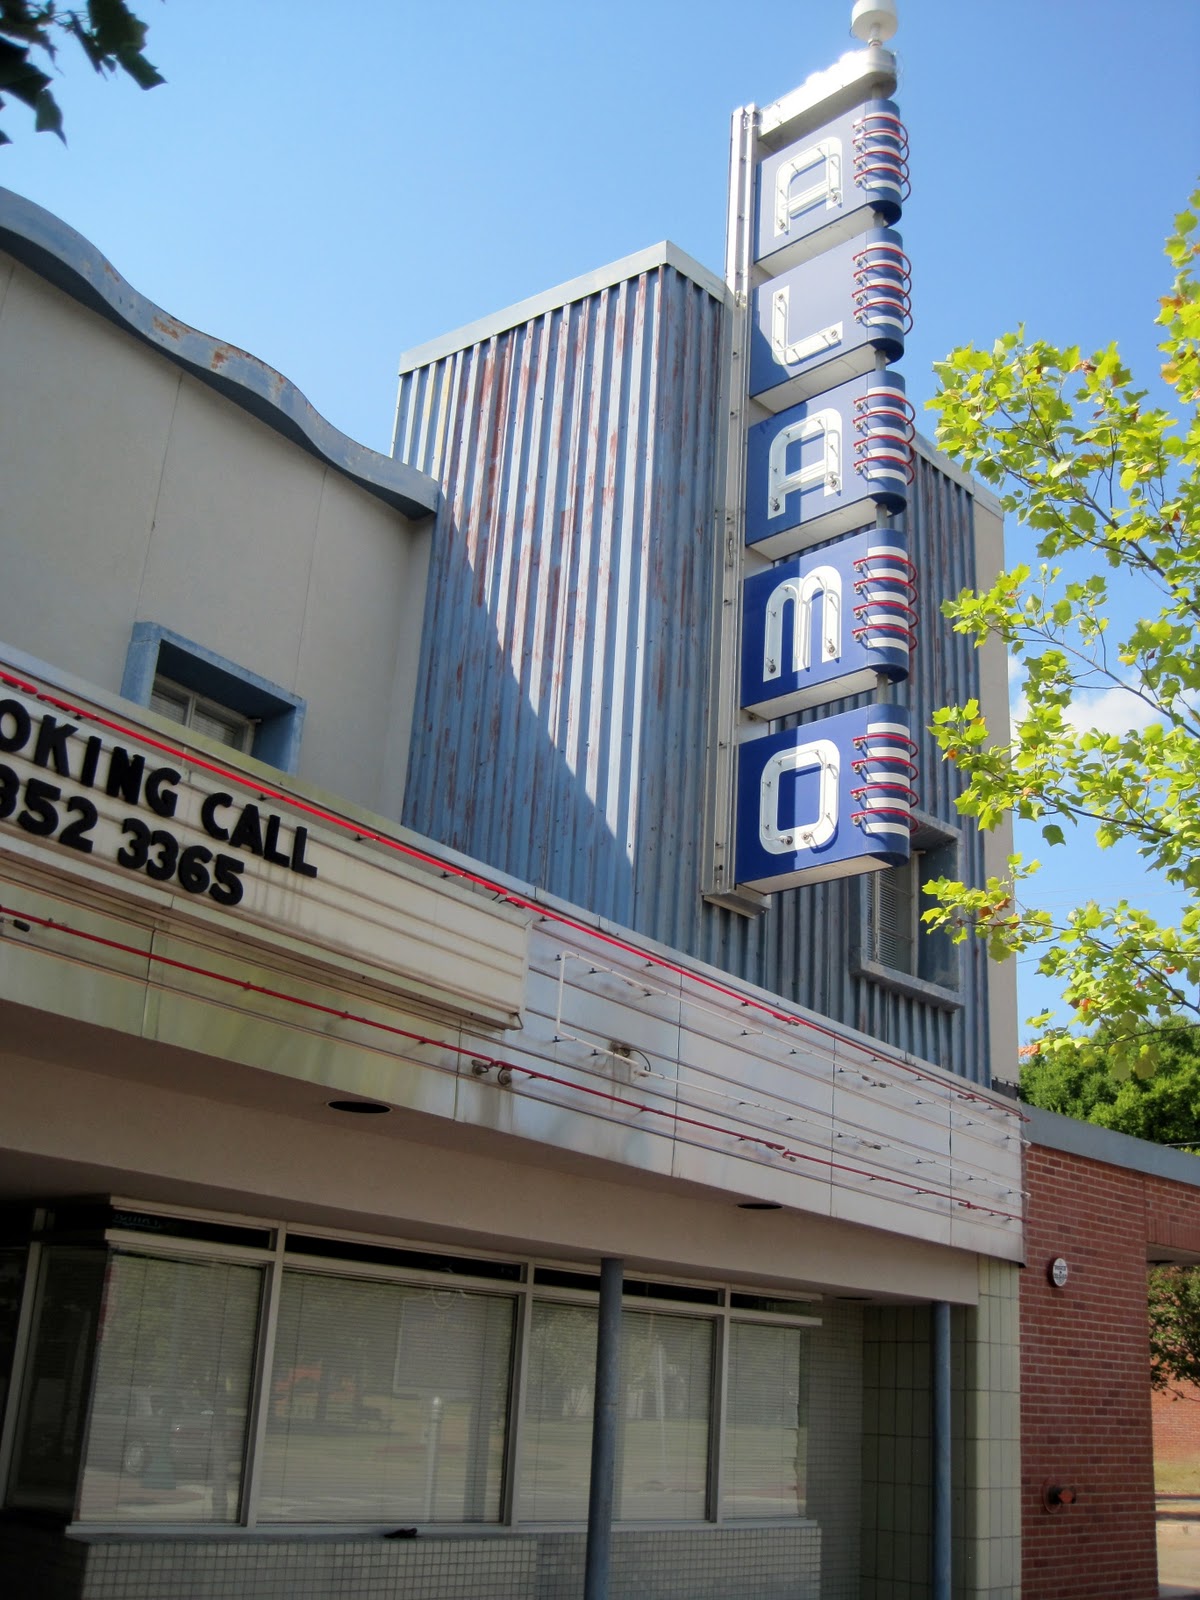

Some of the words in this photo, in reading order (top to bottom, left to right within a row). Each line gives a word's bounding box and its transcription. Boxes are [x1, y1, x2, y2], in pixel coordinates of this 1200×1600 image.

[759, 136, 843, 855] ALAMO
[0, 699, 182, 818] OKING
[201, 792, 318, 879] CALL
[117, 817, 245, 906] 3365
